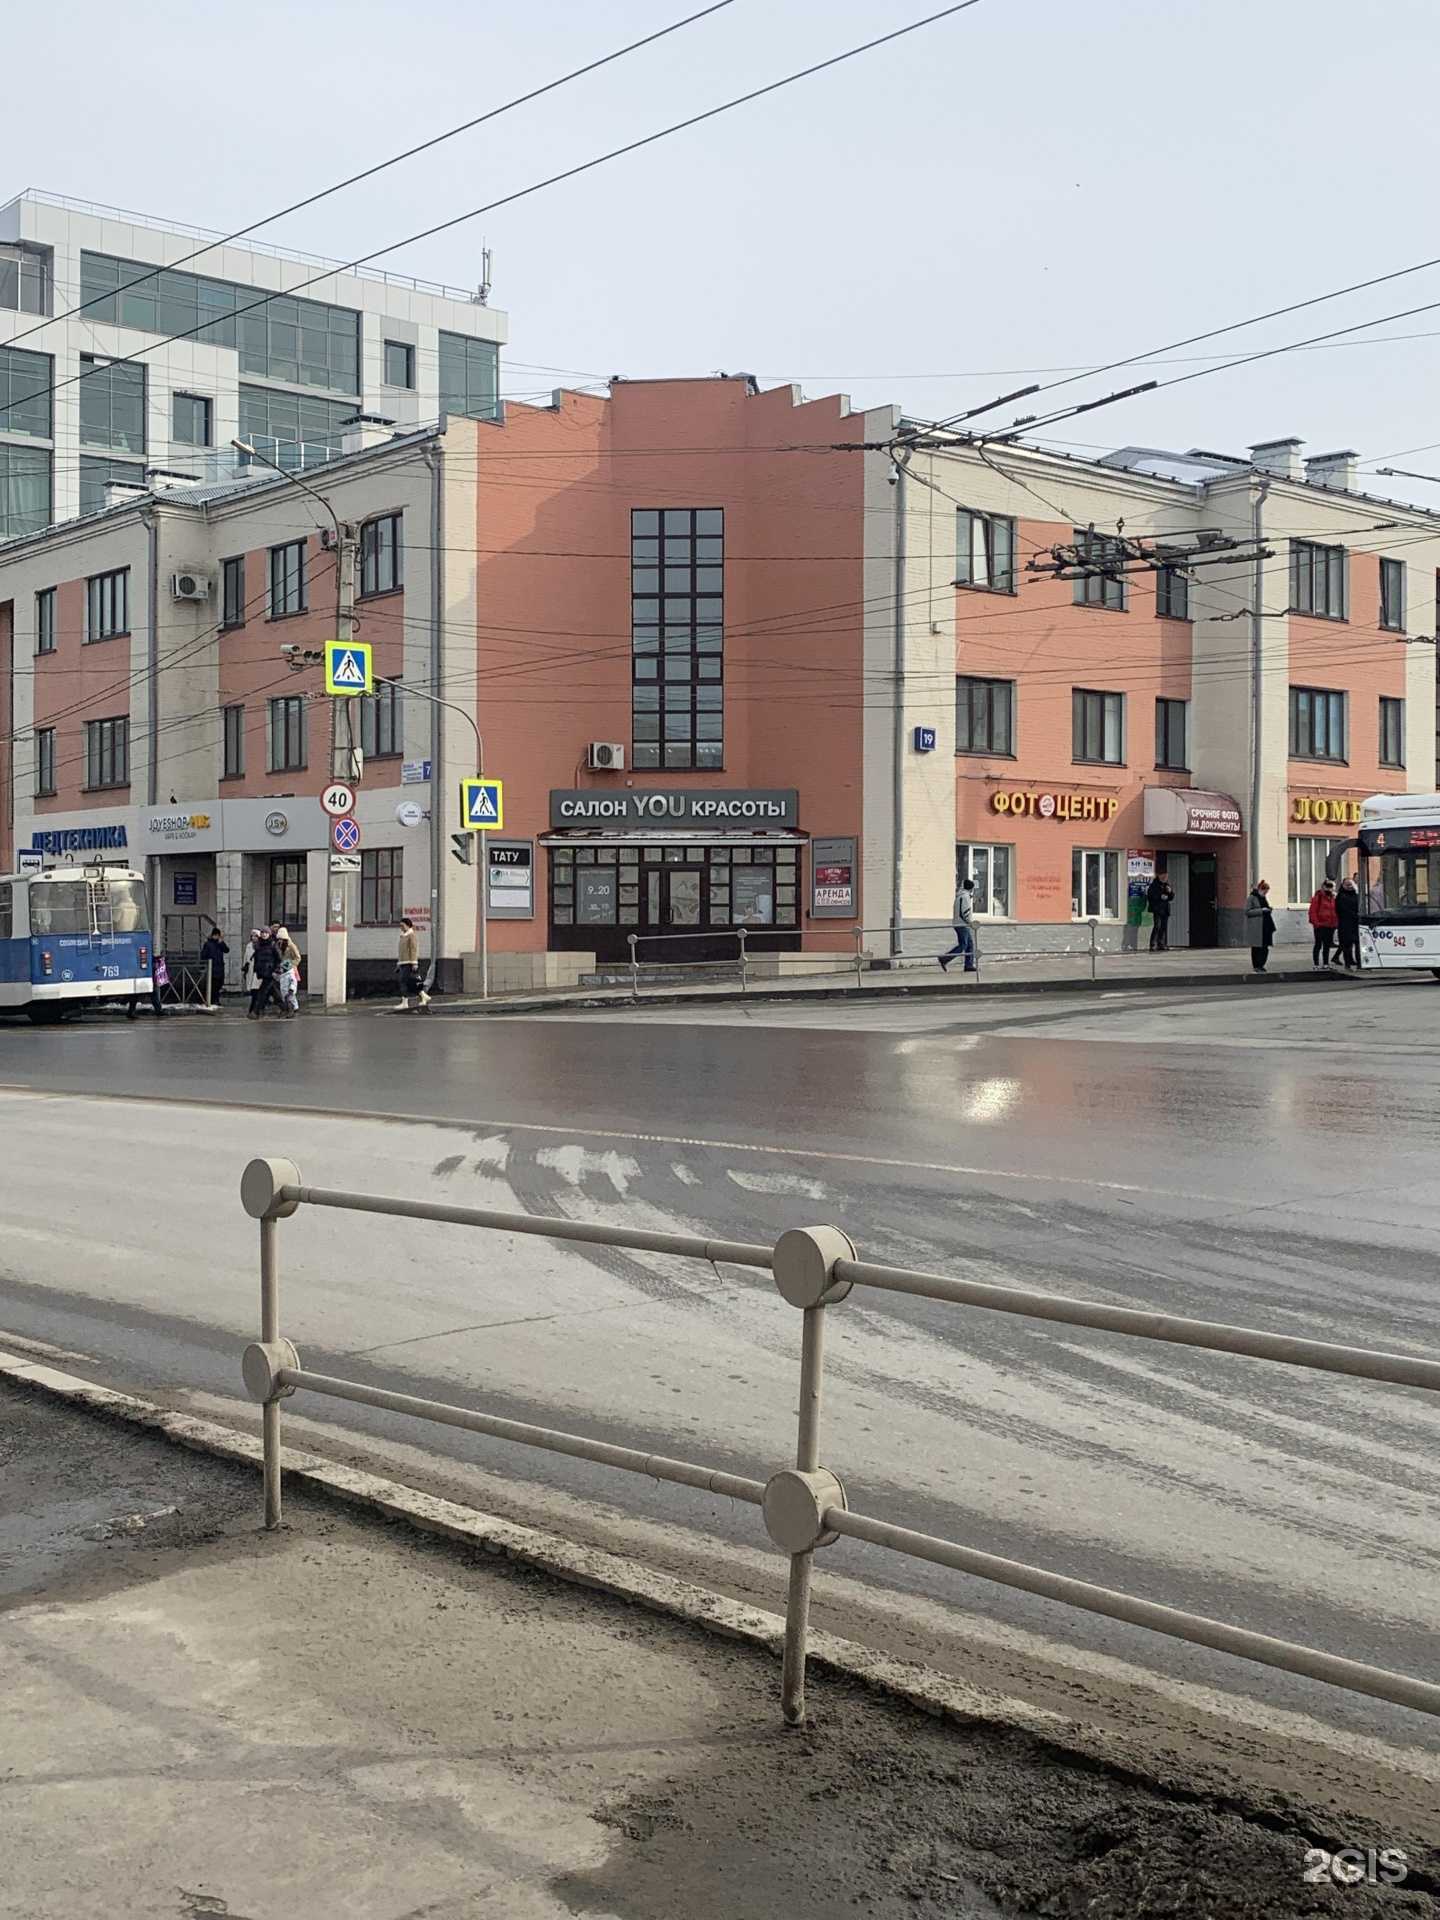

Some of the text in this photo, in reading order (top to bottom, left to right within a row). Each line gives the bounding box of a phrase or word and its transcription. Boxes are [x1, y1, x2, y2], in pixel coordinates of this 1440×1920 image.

[924, 733, 934, 745] 19
[328, 792, 347, 808] 40
[560, 795, 786, 817] САЛОН YOU КРАСОТЫ
[1191, 808, 1240, 820] СРОЧНОЕ ФОТО
[1190, 819, 1240, 832] НА ДОКУМЕНТЫ
[32, 825, 128, 856] МЕДТЕХНИКА
[1376, 832, 1386, 848] 4
[492, 850, 519, 863] ТАТУ
[816, 889, 850, 899] АРЕНДА
[1393, 935, 1406, 947] 942
[101, 965, 120, 977] 769
